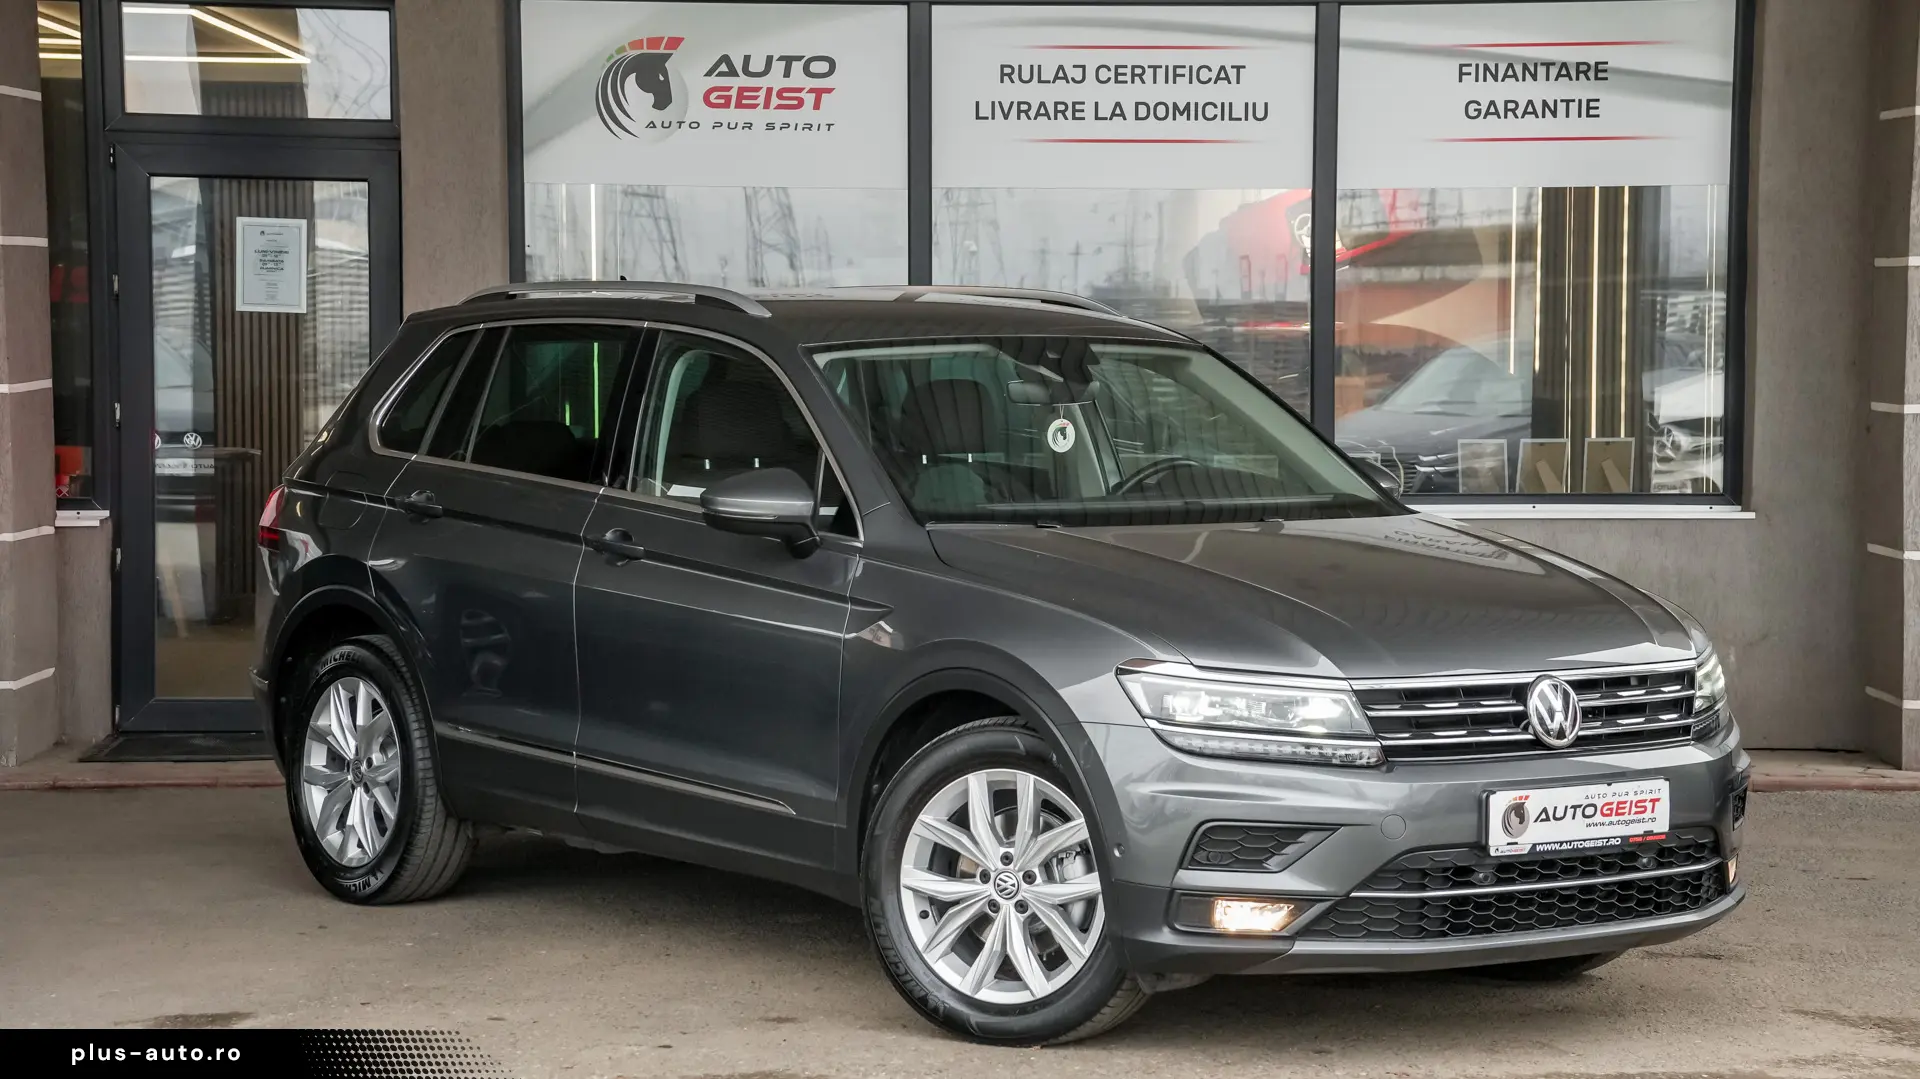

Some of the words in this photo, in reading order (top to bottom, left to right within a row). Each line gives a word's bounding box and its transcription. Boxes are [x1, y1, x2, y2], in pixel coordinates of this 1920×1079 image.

[703, 53, 837, 79] AUTO
[999, 64, 1087, 84] RULAJ
[1095, 64, 1247, 85] CERTIFICAT
[1458, 61, 1609, 83] FINANTARE
[702, 86, 836, 111] GEIST
[1464, 98, 1601, 120] GARANTIE
[975, 101, 1086, 121] LIVRARE
[1094, 101, 1127, 121] LA
[1134, 101, 1269, 122] DOMICILIU
[645, 120, 701, 130] AUTO
[712, 121, 754, 131] PUR
[765, 122, 836, 132] SPIRIT
[1584, 790, 1608, 800] AUTO
[1612, 790, 1630, 798] PUR
[1633, 788, 1662, 796] SPIRIT
[1585, 816, 1657, 829] www.autogeist.ro
[1535, 837, 1622, 852] WWW.AUTOGEIST.RO
